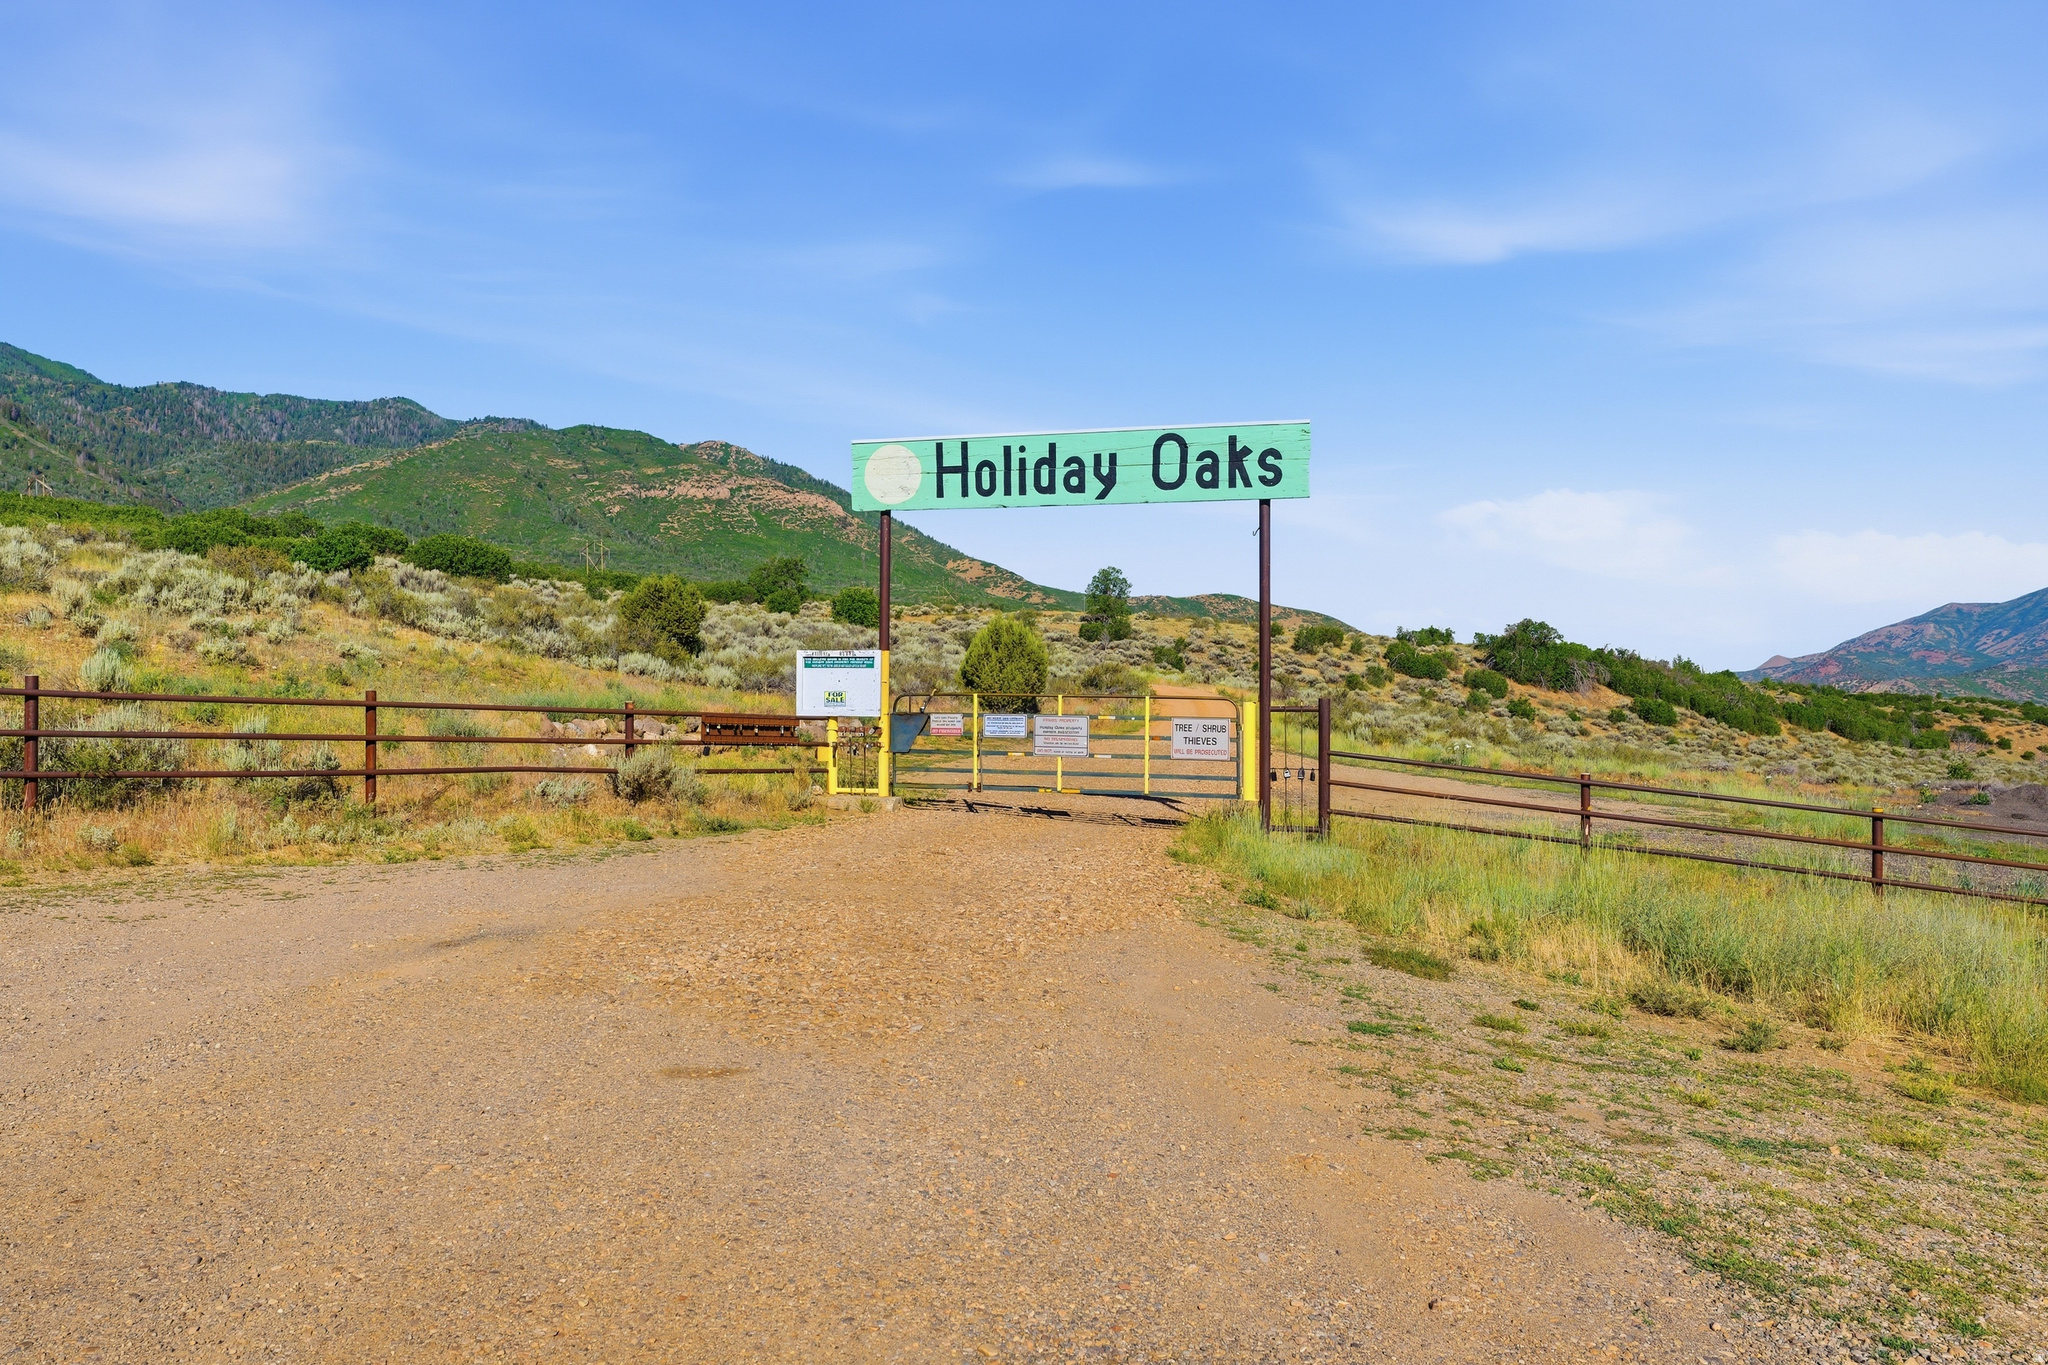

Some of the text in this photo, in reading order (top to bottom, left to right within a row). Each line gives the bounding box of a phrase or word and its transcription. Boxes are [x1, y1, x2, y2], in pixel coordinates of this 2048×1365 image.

[935, 432, 1284, 500] Holiday Oaks
[1175, 723, 1192, 732] TREE
[1202, 724, 1227, 733] SHRUB
[1183, 737, 1217, 745] THIEVES
